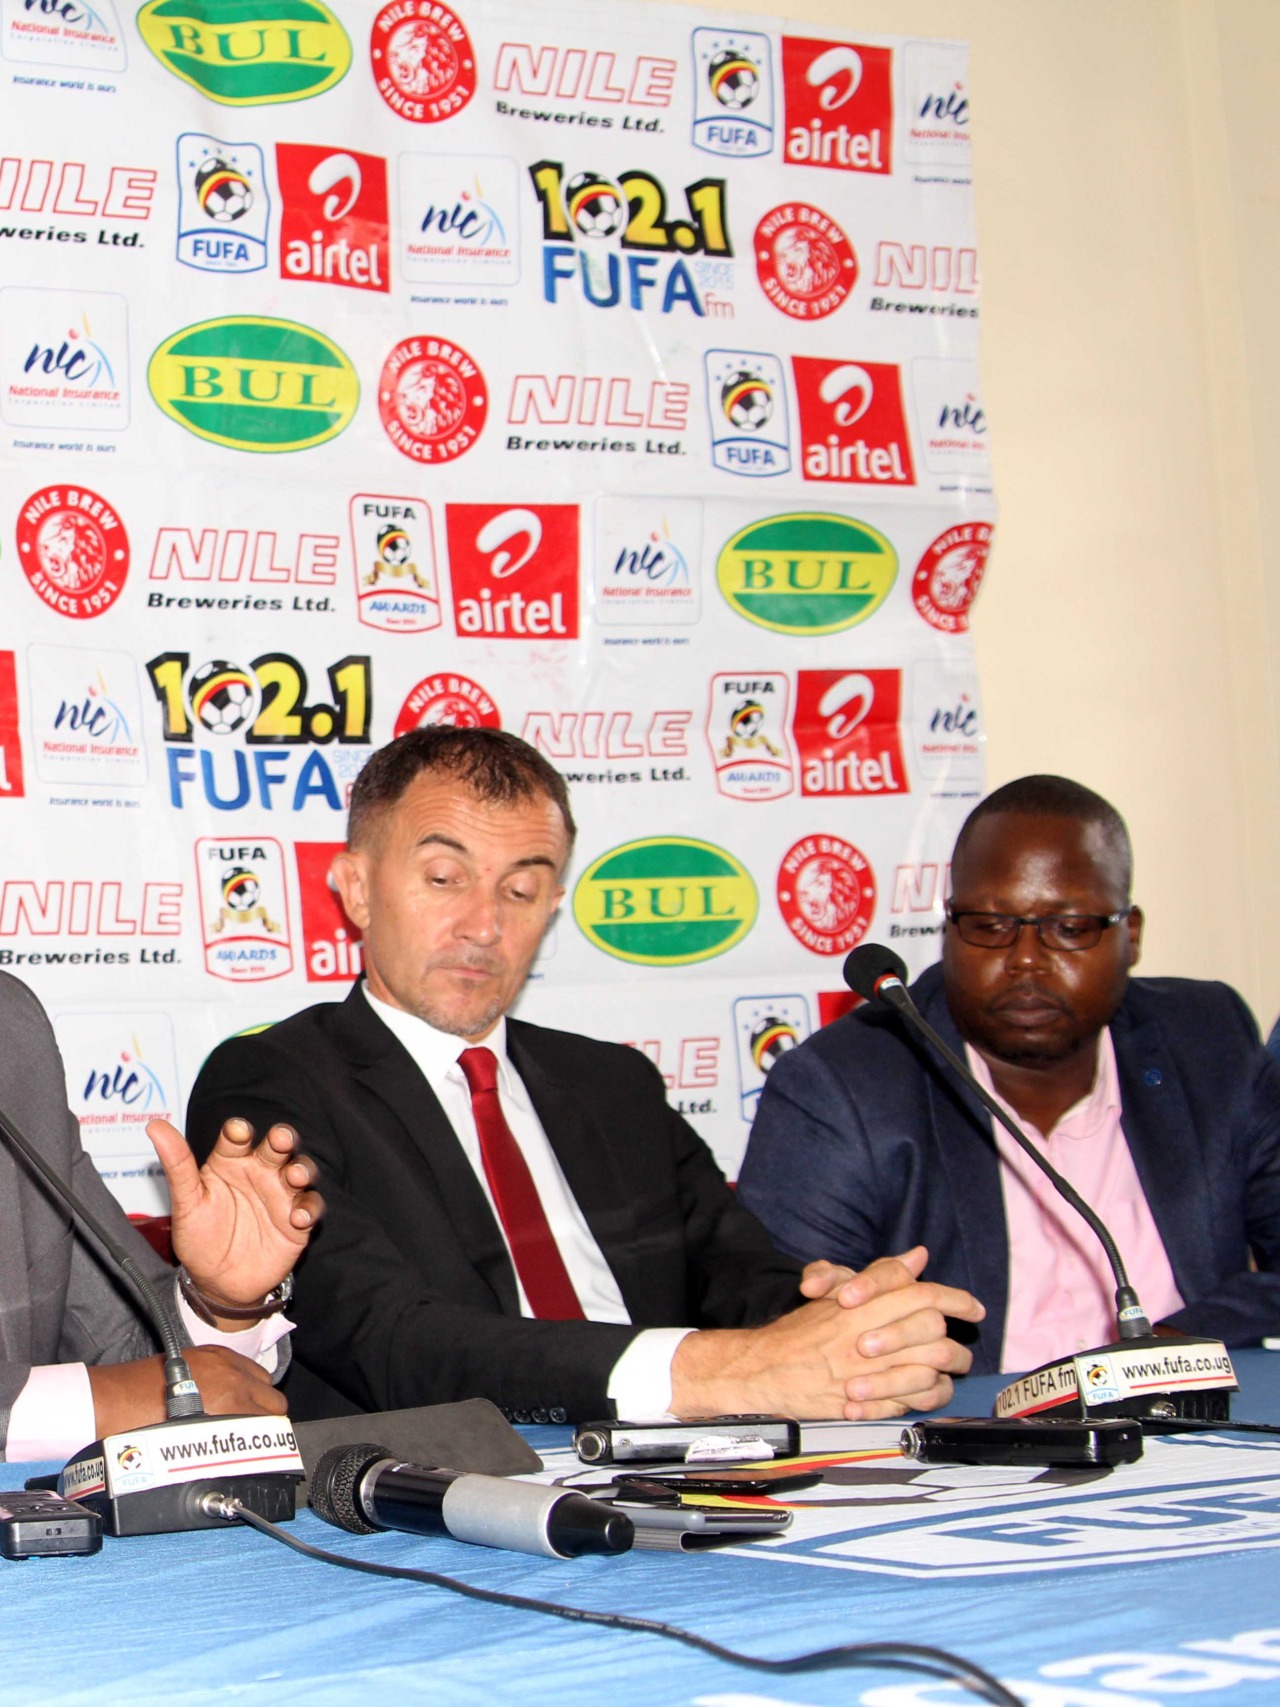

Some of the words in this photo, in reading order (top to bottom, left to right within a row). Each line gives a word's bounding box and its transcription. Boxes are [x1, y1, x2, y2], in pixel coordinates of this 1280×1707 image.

[378, 2, 415, 33] NILE
[420, 2, 465, 43] BREW
[168, 24, 326, 62] BUL
[493, 43, 677, 107] NILE
[377, 79, 424, 118] SINCE
[430, 84, 472, 118] 1951
[496, 101, 613, 129] Breweries
[623, 116, 665, 133] Ltd.
[707, 125, 759, 147] FUFA
[788, 122, 881, 168] airtel
[421, 190, 488, 239] nic
[762, 208, 796, 238] NILE
[801, 208, 842, 245] BREW
[98, 233, 145, 248] Ltd.
[192, 239, 250, 263] FUFA
[285, 231, 381, 288] airtel
[541, 246, 706, 317] FUFA
[763, 278, 806, 317] SINCE
[810, 284, 849, 317] 1951
[703, 294, 734, 319] fm
[23, 328, 95, 381] nic
[387, 346, 423, 372] NILE
[427, 343, 476, 377] BREW
[9, 385, 59, 399] National
[62, 388, 120, 400] Insurance
[181, 364, 337, 408] BUL
[506, 375, 690, 430] NILE
[386, 418, 432, 460] SINCE
[437, 424, 478, 460] 1951
[506, 436, 638, 455] Breweries
[646, 441, 687, 456] Ltd.
[726, 446, 775, 467] FUFA
[806, 440, 906, 482] airtel
[25, 492, 61, 524] NILE
[66, 490, 118, 529] BREW
[363, 504, 416, 520] FUFA
[149, 528, 340, 585] NILE
[614, 532, 674, 580] nic
[30, 571, 79, 615] SINCE
[83, 580, 119, 614] 1951
[740, 558, 871, 592] BUL
[147, 592, 282, 611] Breweries
[293, 597, 335, 612] Ltd.
[456, 588, 566, 634] airtel
[408, 679, 445, 713] NILE
[448, 678, 494, 715] BREW
[723, 681, 775, 695] FUFA
[54, 686, 114, 737] nic
[521, 710, 693, 759] NILE
[163, 748, 342, 812] FUFA
[650, 766, 691, 782] Ltd.
[802, 751, 898, 792] airtel
[208, 846, 268, 861] FUFA
[601, 884, 735, 920] BUL
[139, 949, 182, 965] Ltd.
[83, 1052, 146, 1105] nic
[1023, 1371, 1056, 1401] FUFA
[1058, 1366, 1077, 1389] fm
[1122, 1355, 1231, 1380] www.fufa.co.ug
[1093, 1391, 1114, 1401] FUFA
[160, 1431, 297, 1462] www.fufa.co.ug
[122, 1476, 147, 1486] FUFA
